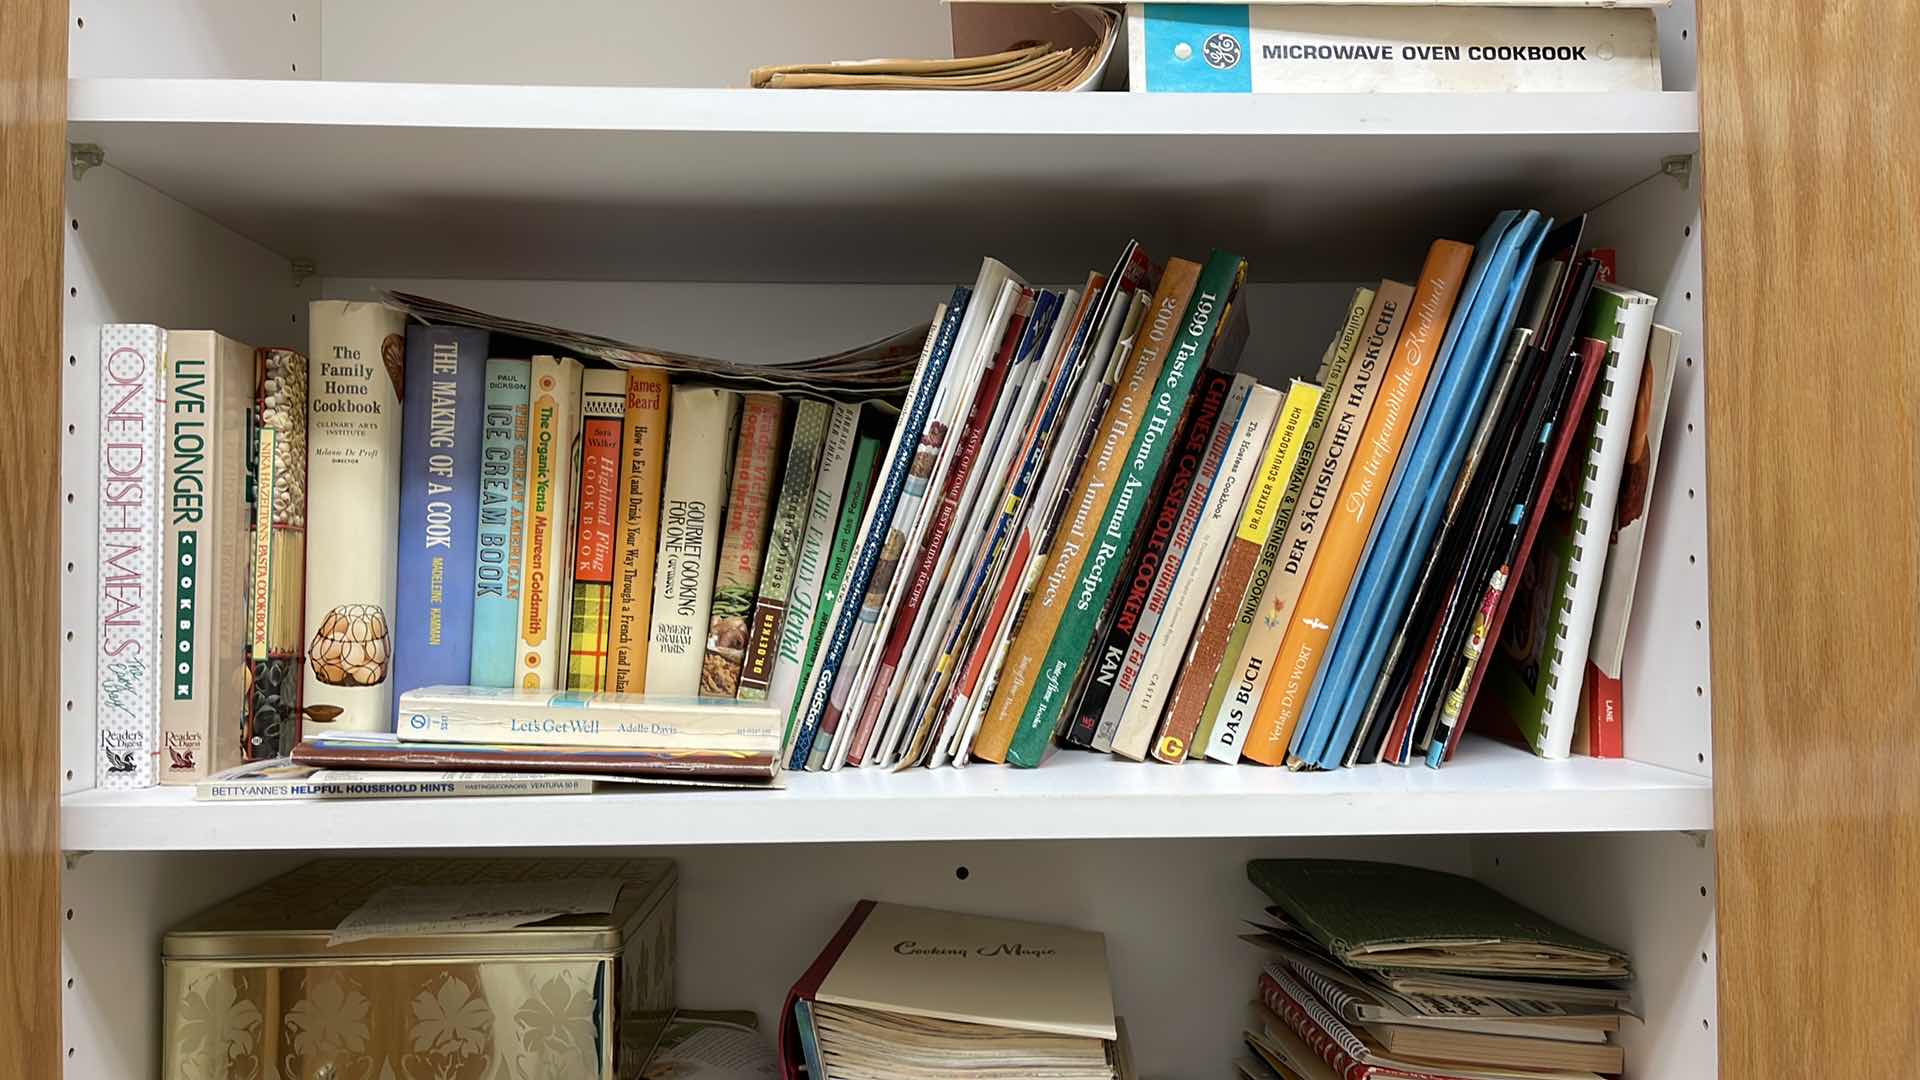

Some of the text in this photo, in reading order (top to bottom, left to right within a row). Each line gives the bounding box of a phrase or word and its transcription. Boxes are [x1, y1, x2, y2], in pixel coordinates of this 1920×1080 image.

[1262, 45, 1587, 61] MICROWAVE OVEN COOKBOOK
[333, 346, 361, 360] The
[937, 316, 957, 355] Cook's
[320, 363, 373, 379] Family
[325, 381, 368, 395] Home
[490, 382, 527, 390] DICKSON
[628, 376, 662, 393] James
[909, 358, 942, 430] Companion
[1308, 304, 1367, 430] Culinary Arts Institute
[313, 400, 381, 414] Cookbook
[316, 421, 378, 429] CULINARY ARTS
[628, 394, 660, 410] Beard
[829, 406, 848, 435] PETER
[1185, 377, 1228, 452] CHINESE
[1340, 275, 1455, 523] Das tierfreundliche Kochbuch
[172, 360, 205, 524] LIVE LONGER
[425, 341, 459, 550] THE MAKING OF A COOK
[958, 455, 970, 470] OF
[964, 428, 981, 455] TASTE
[1036, 296, 1177, 610] 2000 Taste of Home Annual Recipes
[1073, 288, 1216, 613] 1999 Taste of Home Annual Recipes
[1201, 421, 1232, 478] MODERN
[1262, 406, 1306, 482] SCHULKOCHBUCH
[1283, 297, 1399, 575] DER SÄCHSISCHEN HAUSKÜCHE
[882, 450, 910, 508] Microwave
[948, 470, 965, 498] HOME
[1210, 420, 1258, 520] The Hostess Cookbook
[103, 347, 143, 657] ONE DISH MEALS
[477, 404, 512, 598] ICE CREAM BOOK
[507, 404, 528, 599] THE GREAT AMERICAN
[528, 407, 551, 634] The Organic Yenta Maureen Goldsmith
[575, 456, 599, 571] COOKBOOK
[590, 456, 617, 572] Highland Fling
[667, 500, 687, 526] FOR
[810, 488, 833, 520] THE
[872, 512, 888, 537] and
[1147, 451, 1199, 551] CASSEROLE
[1172, 481, 1208, 551] BARBECUE
[254, 442, 270, 645] NIKA HAZELTON'S PASTA COOKBOOK
[617, 425, 647, 665] How to Eat (and Drink) Your Way Through French (and
[664, 526, 683, 553] ONE
[676, 500, 707, 616] GOURMET COOKING
[770, 489, 801, 588] SCHULKOCHBUCH
[794, 525, 825, 585] FAMILY
[907, 505, 952, 608] BEST HOLIDAY RECIPES
[1239, 438, 1316, 624] GERMAN & VIENNESE COOKING
[429, 556, 443, 604] MADELEINE
[829, 556, 843, 580] Rund
[847, 540, 877, 608] Convection
[1115, 550, 1161, 634] COOKERY
[1148, 553, 1181, 614] COOKING
[177, 535, 192, 696] COOKBOOK
[774, 587, 817, 665] Herbal
[827, 610, 853, 661] Cooking
[1133, 630, 1149, 648] by
[1096, 645, 1123, 685] KAN
[1127, 649, 1144, 667] Ed
[801, 668, 834, 731] GoldStar
[1139, 673, 1160, 709] CASTLE
[1215, 654, 1269, 747] DAS BUCH
[1266, 643, 1314, 744] Verlag DAS WORT
[1605, 700, 1614, 722] LANE
[101, 730, 143, 748] Reader's
[118, 739, 143, 749] Digest
[164, 731, 201, 747] Reader's
[511, 719, 599, 733] Let's Get Well
[617, 723, 677, 734] Adelle Davis
[212, 783, 455, 797] BETTY-ANNE'S HELPFUL HOUSEHOLD HINTS
[893, 941, 1056, 958] Cooking Magic
